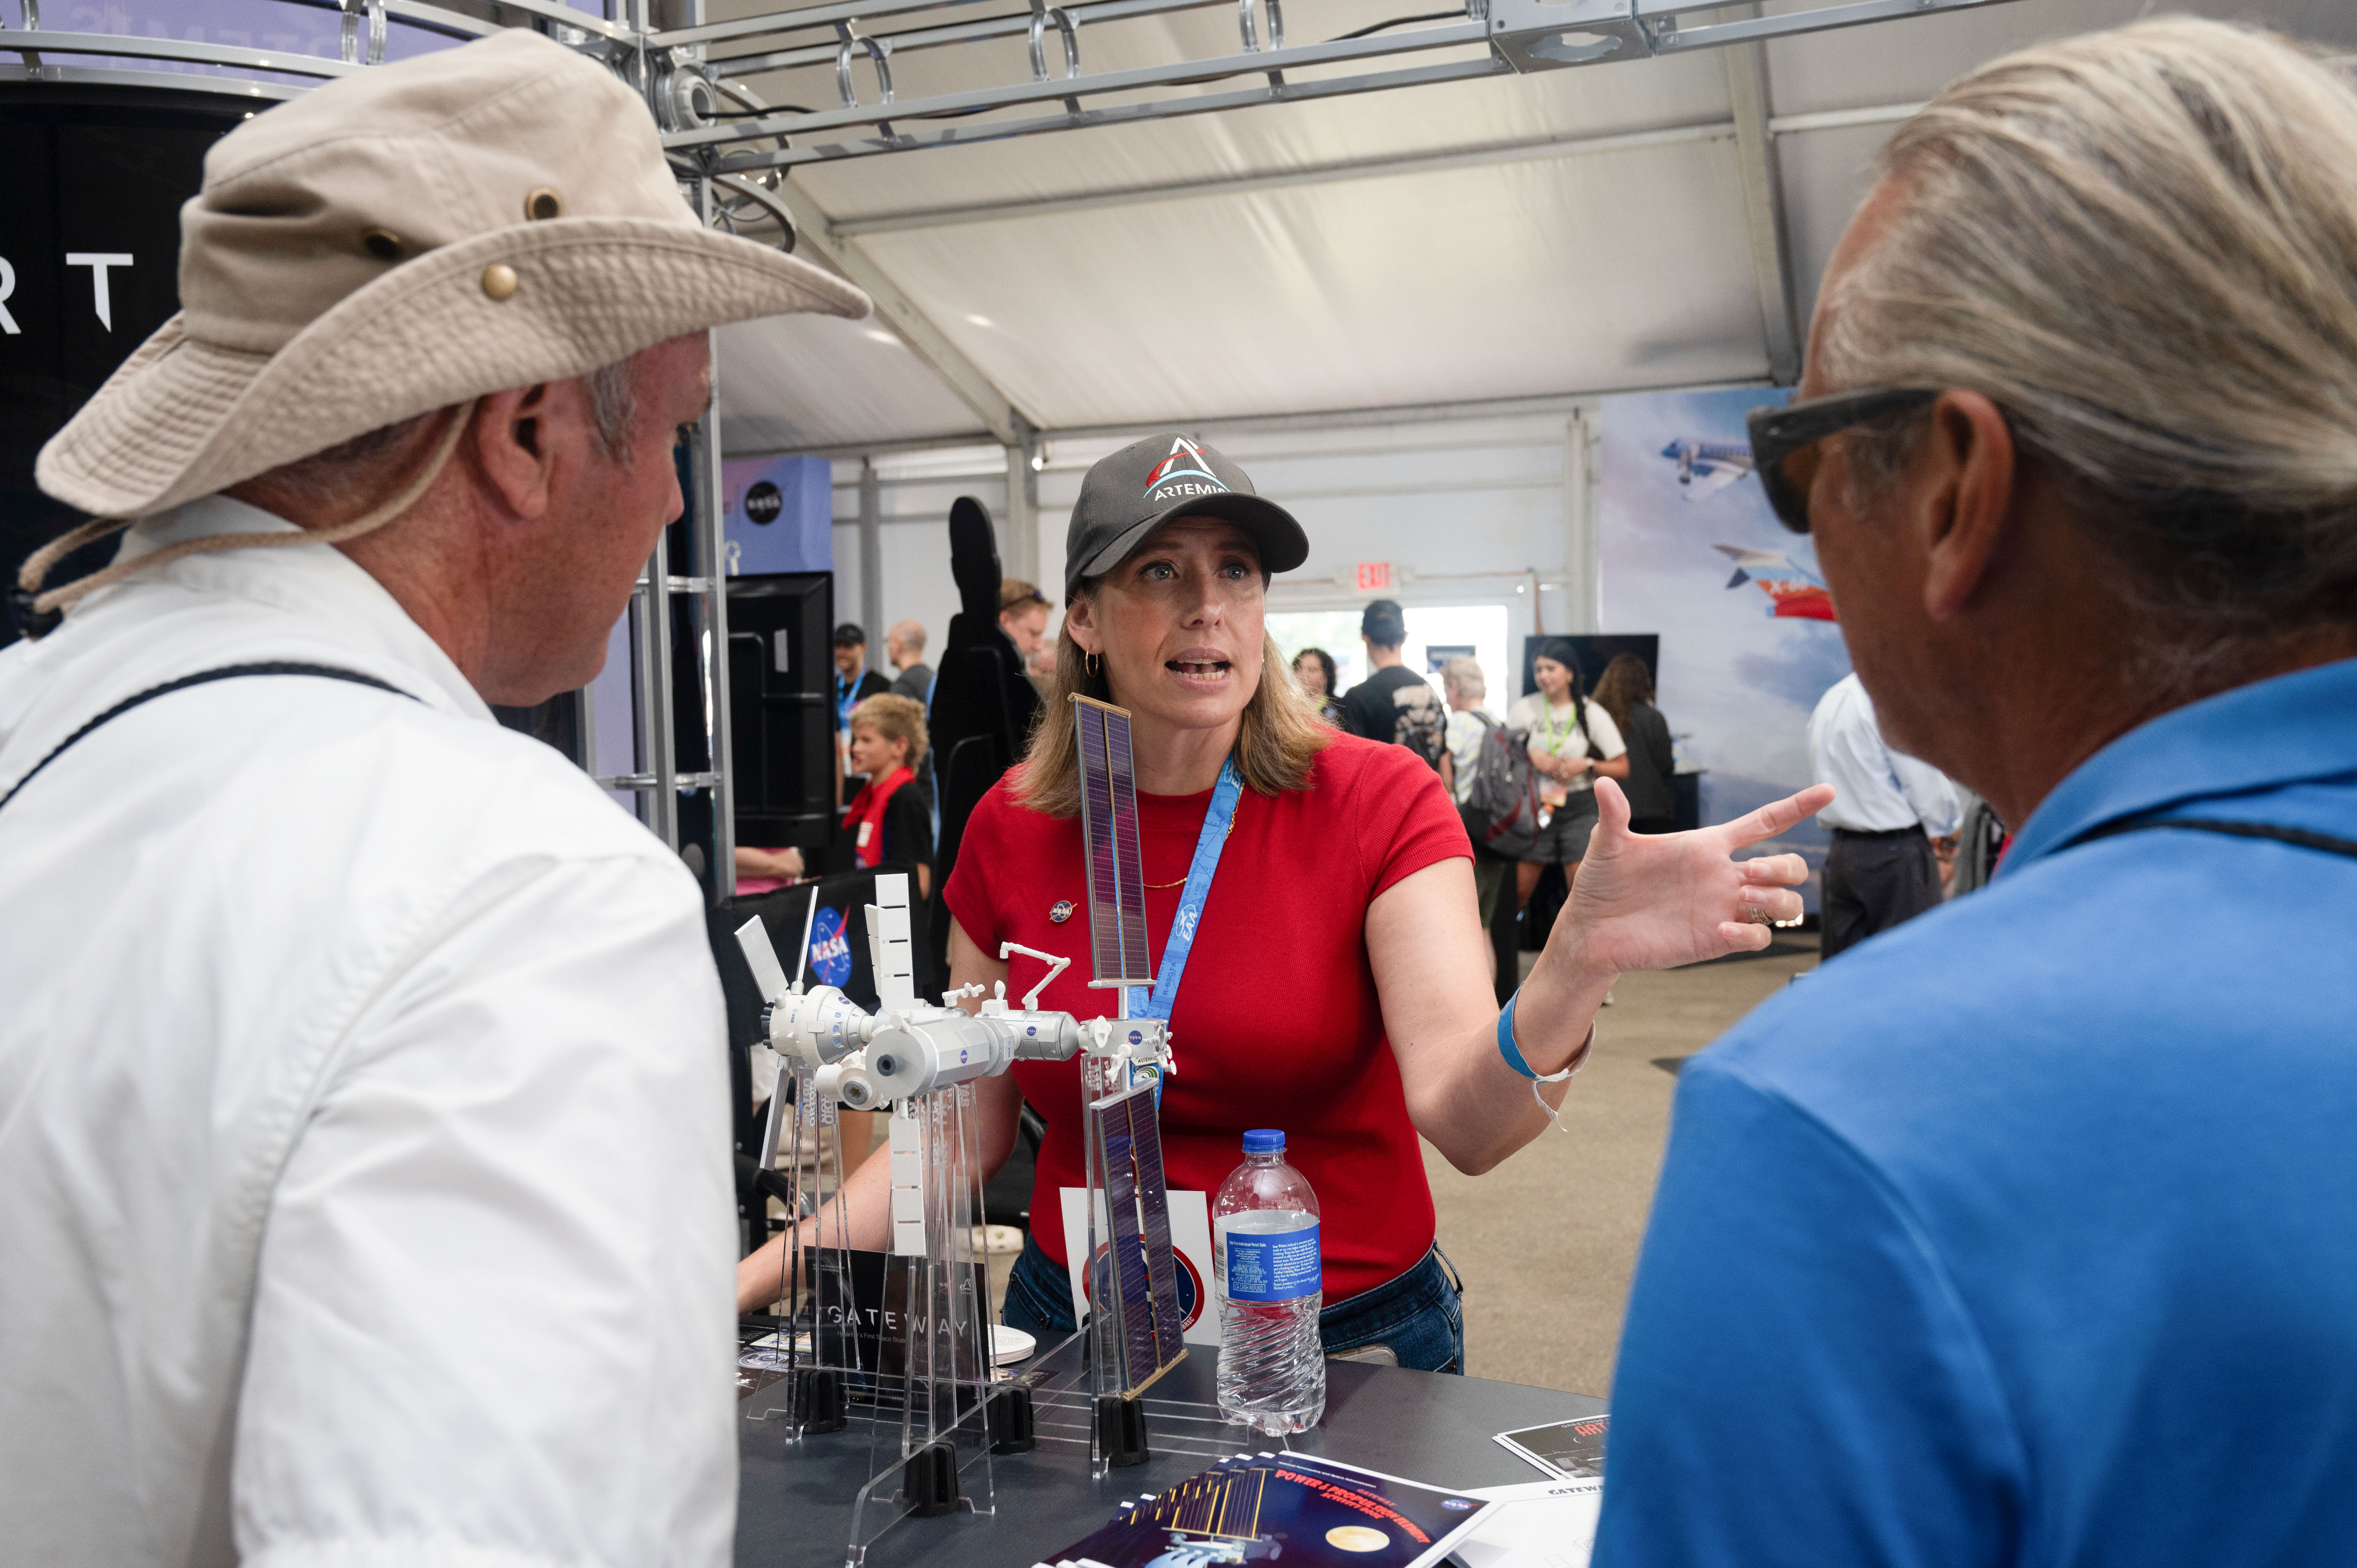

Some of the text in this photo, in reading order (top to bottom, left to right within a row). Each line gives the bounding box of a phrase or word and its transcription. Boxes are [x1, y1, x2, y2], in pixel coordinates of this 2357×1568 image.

[1358, 563, 1389, 590] EXIT
[1182, 912, 1197, 942] EAA
[811, 936, 848, 962] NASA
[828, 1306, 967, 1337] GATEWAY
[1561, 1419, 1604, 1428] GREETINGS
[1275, 1469, 1323, 1488] POWER
[1327, 1486, 1400, 1519] PROPULSION
[1393, 1517, 1431, 1543] ELEMENT
